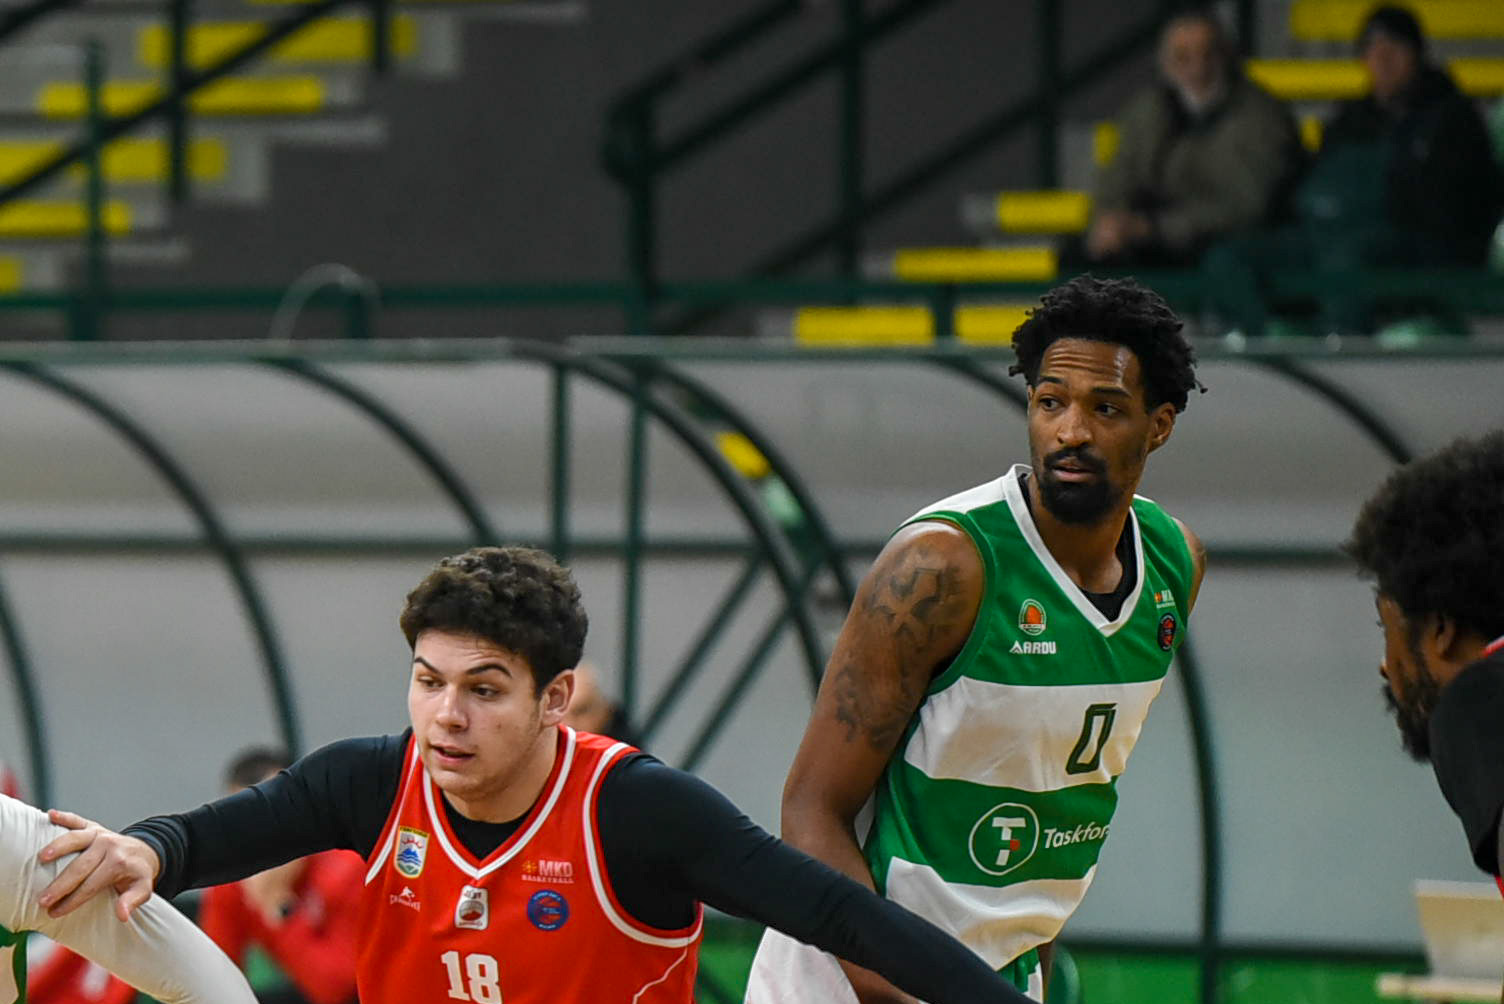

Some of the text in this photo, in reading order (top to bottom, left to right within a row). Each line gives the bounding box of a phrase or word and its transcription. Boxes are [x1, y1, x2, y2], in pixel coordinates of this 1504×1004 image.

[1066, 703, 1117, 775] 0
[1043, 821, 1110, 849] Taskfor
[539, 860, 573, 877] MKD
